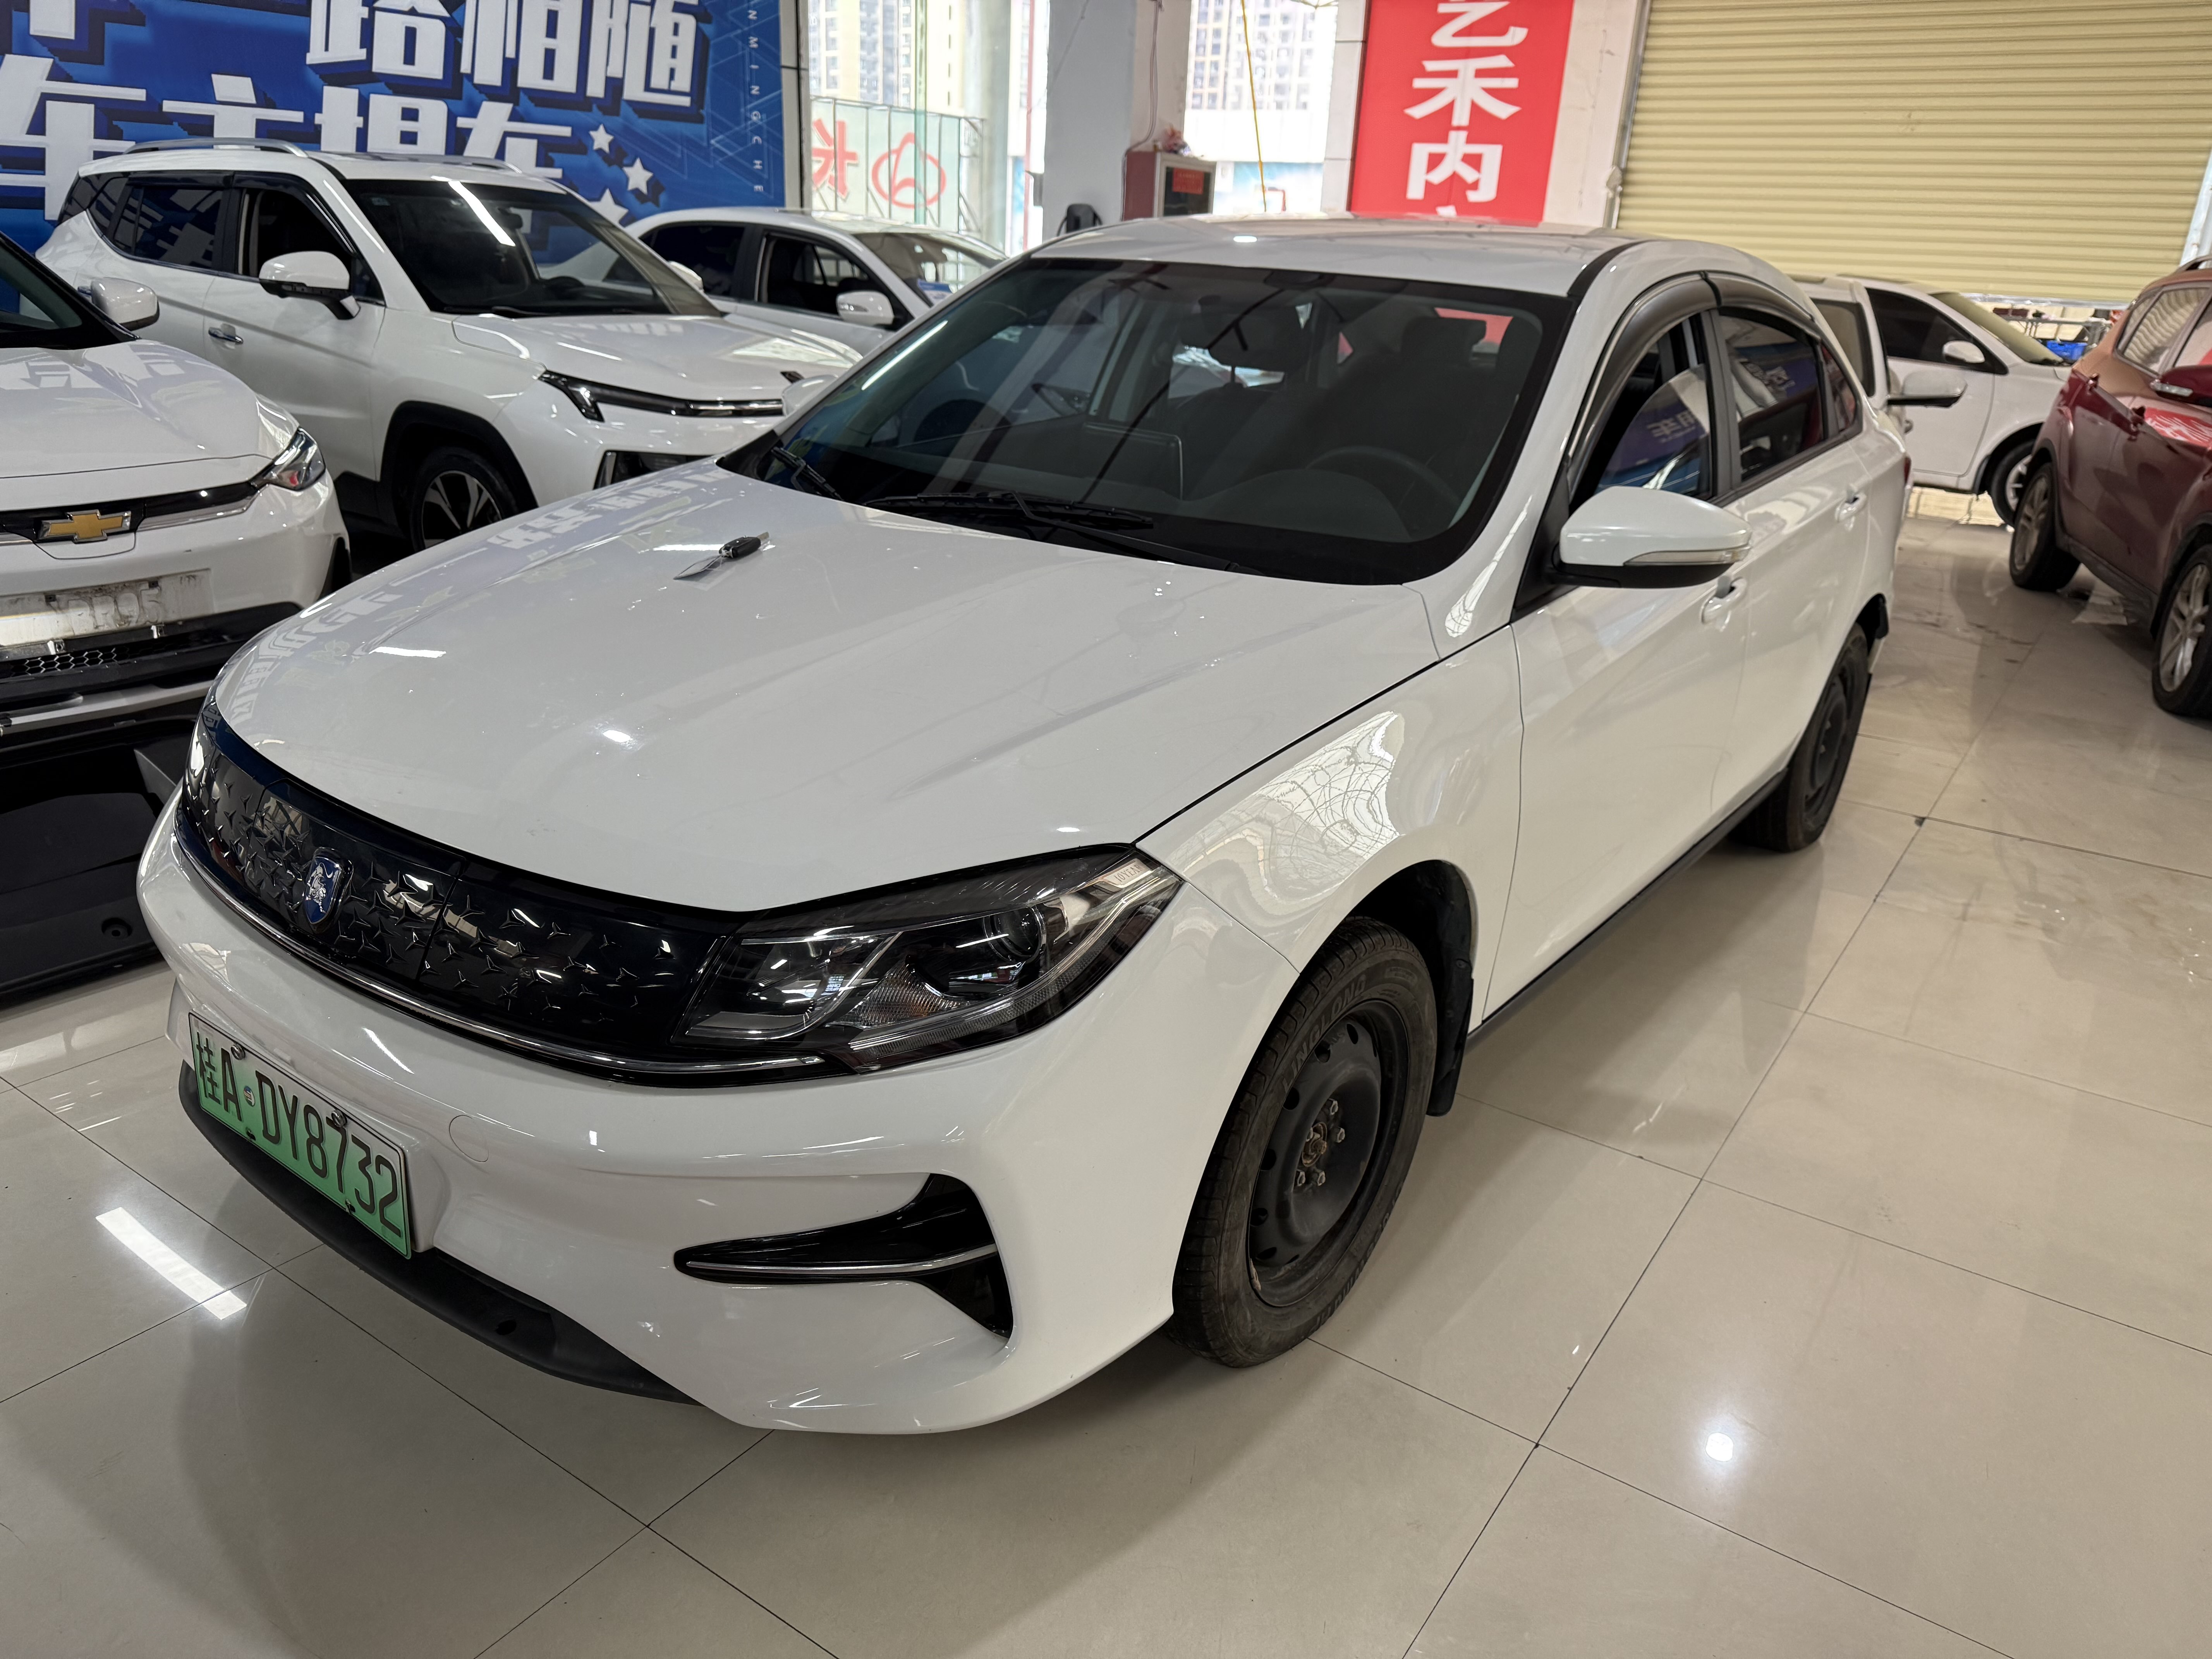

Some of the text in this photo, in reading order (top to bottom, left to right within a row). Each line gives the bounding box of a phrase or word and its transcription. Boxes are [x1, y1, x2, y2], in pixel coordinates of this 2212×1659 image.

[1403, 0, 1528, 218] 艺禾内
[1114, 864, 1142, 883] JOYEAR
